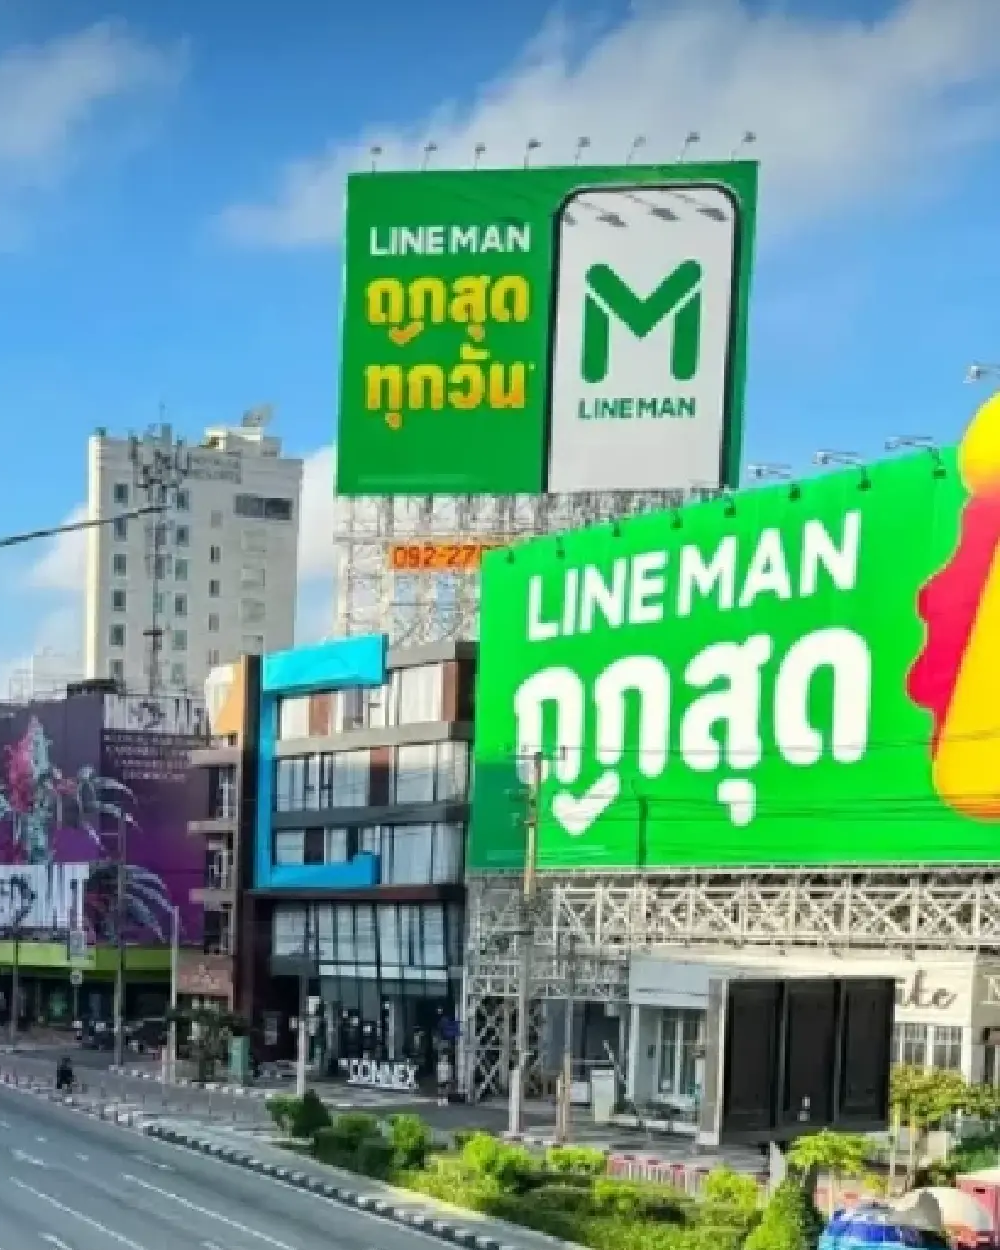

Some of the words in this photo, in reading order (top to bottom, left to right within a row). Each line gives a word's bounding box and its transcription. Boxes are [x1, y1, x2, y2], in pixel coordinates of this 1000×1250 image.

[366, 276, 530, 345] ถูกสุด
[527, 550, 668, 641] LINE
[676, 510, 862, 617] MAN
[514, 626, 872, 837] ถูกสุด
